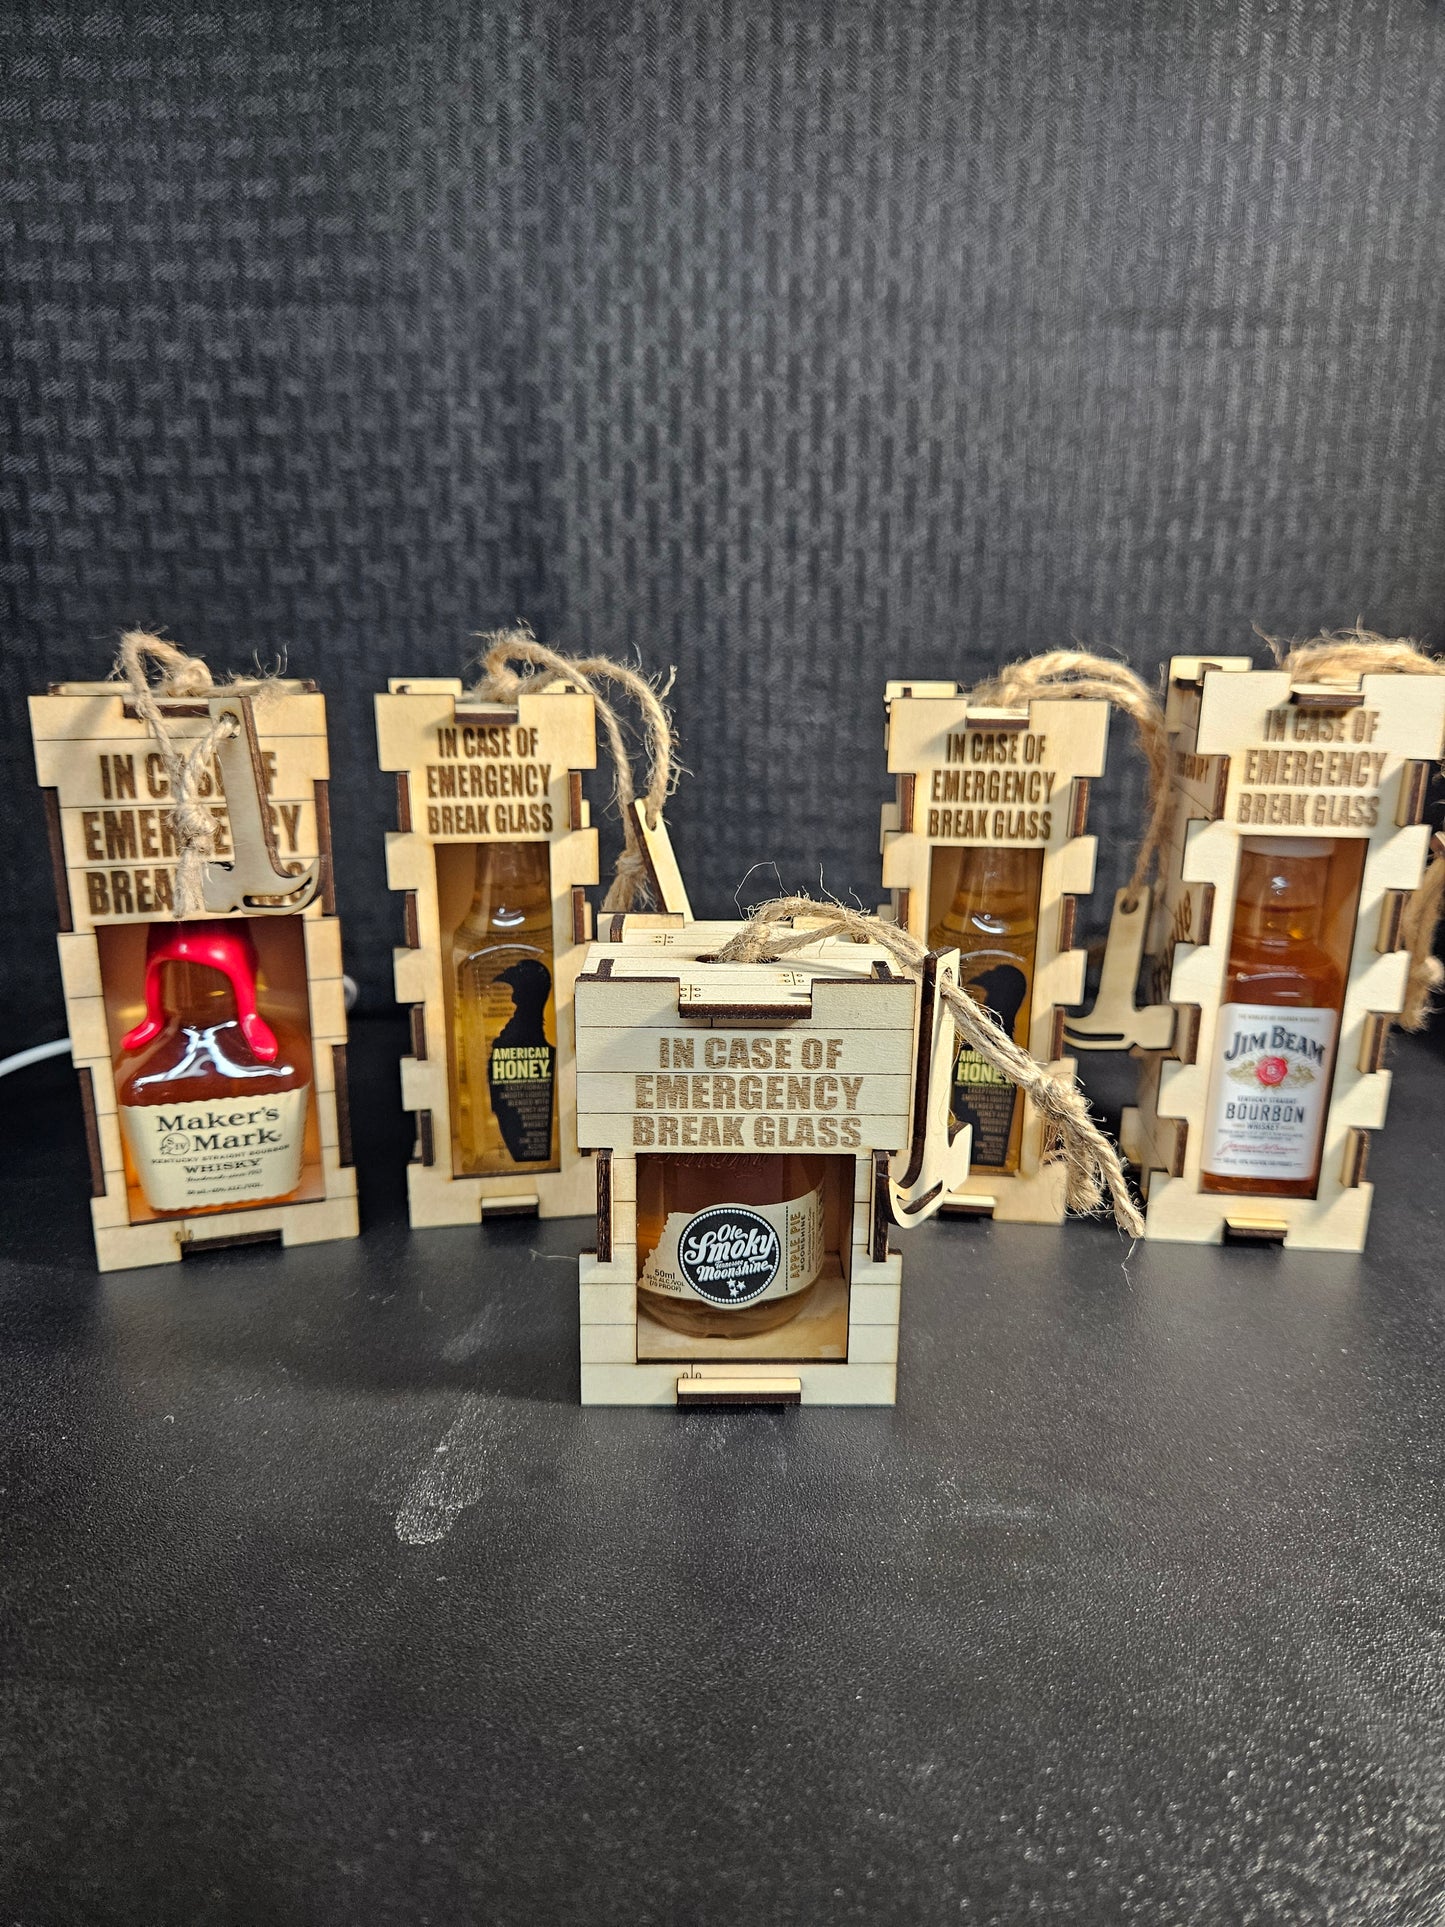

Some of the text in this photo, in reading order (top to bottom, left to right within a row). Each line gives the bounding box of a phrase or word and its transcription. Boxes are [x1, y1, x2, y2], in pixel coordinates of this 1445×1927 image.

[1263, 708, 1380, 744] IN CASE OF
[437, 727, 538, 758] IN CASE OF
[945, 733, 1046, 764] IN CASE OF
[100, 754, 136, 799] IN
[426, 764, 552, 798] EMERGENCY
[1243, 749, 1388, 788] EMERGENCY
[931, 770, 1056, 804] EMERGENCY
[427, 803, 553, 834] BREAK GLASS
[927, 809, 1052, 840] BREAK GLASS
[1237, 793, 1380, 828] BREAK GLASS
[86, 868, 175, 915] BREA
[492, 1047, 549, 1060] AMERICAN
[660, 1037, 844, 1070] IN CASE OF
[1224, 1025, 1326, 1066] JIM BEAM
[635, 1075, 864, 1111] EMERGENCY
[156, 1107, 280, 1132] Maker's
[1225, 1102, 1305, 1123] BOURBON
[194, 1128, 280, 1151] Mark
[632, 1116, 862, 1148] BREAK GLASS
[183, 1158, 262, 1174] WHISKY
[684, 1228, 777, 1266] Smoky
[717, 1223, 748, 1242] Ole
[789, 1211, 801, 1279] APPLE PIE
[655, 1269, 675, 1279] 50ml
[696, 1260, 774, 1282] Moonshine
